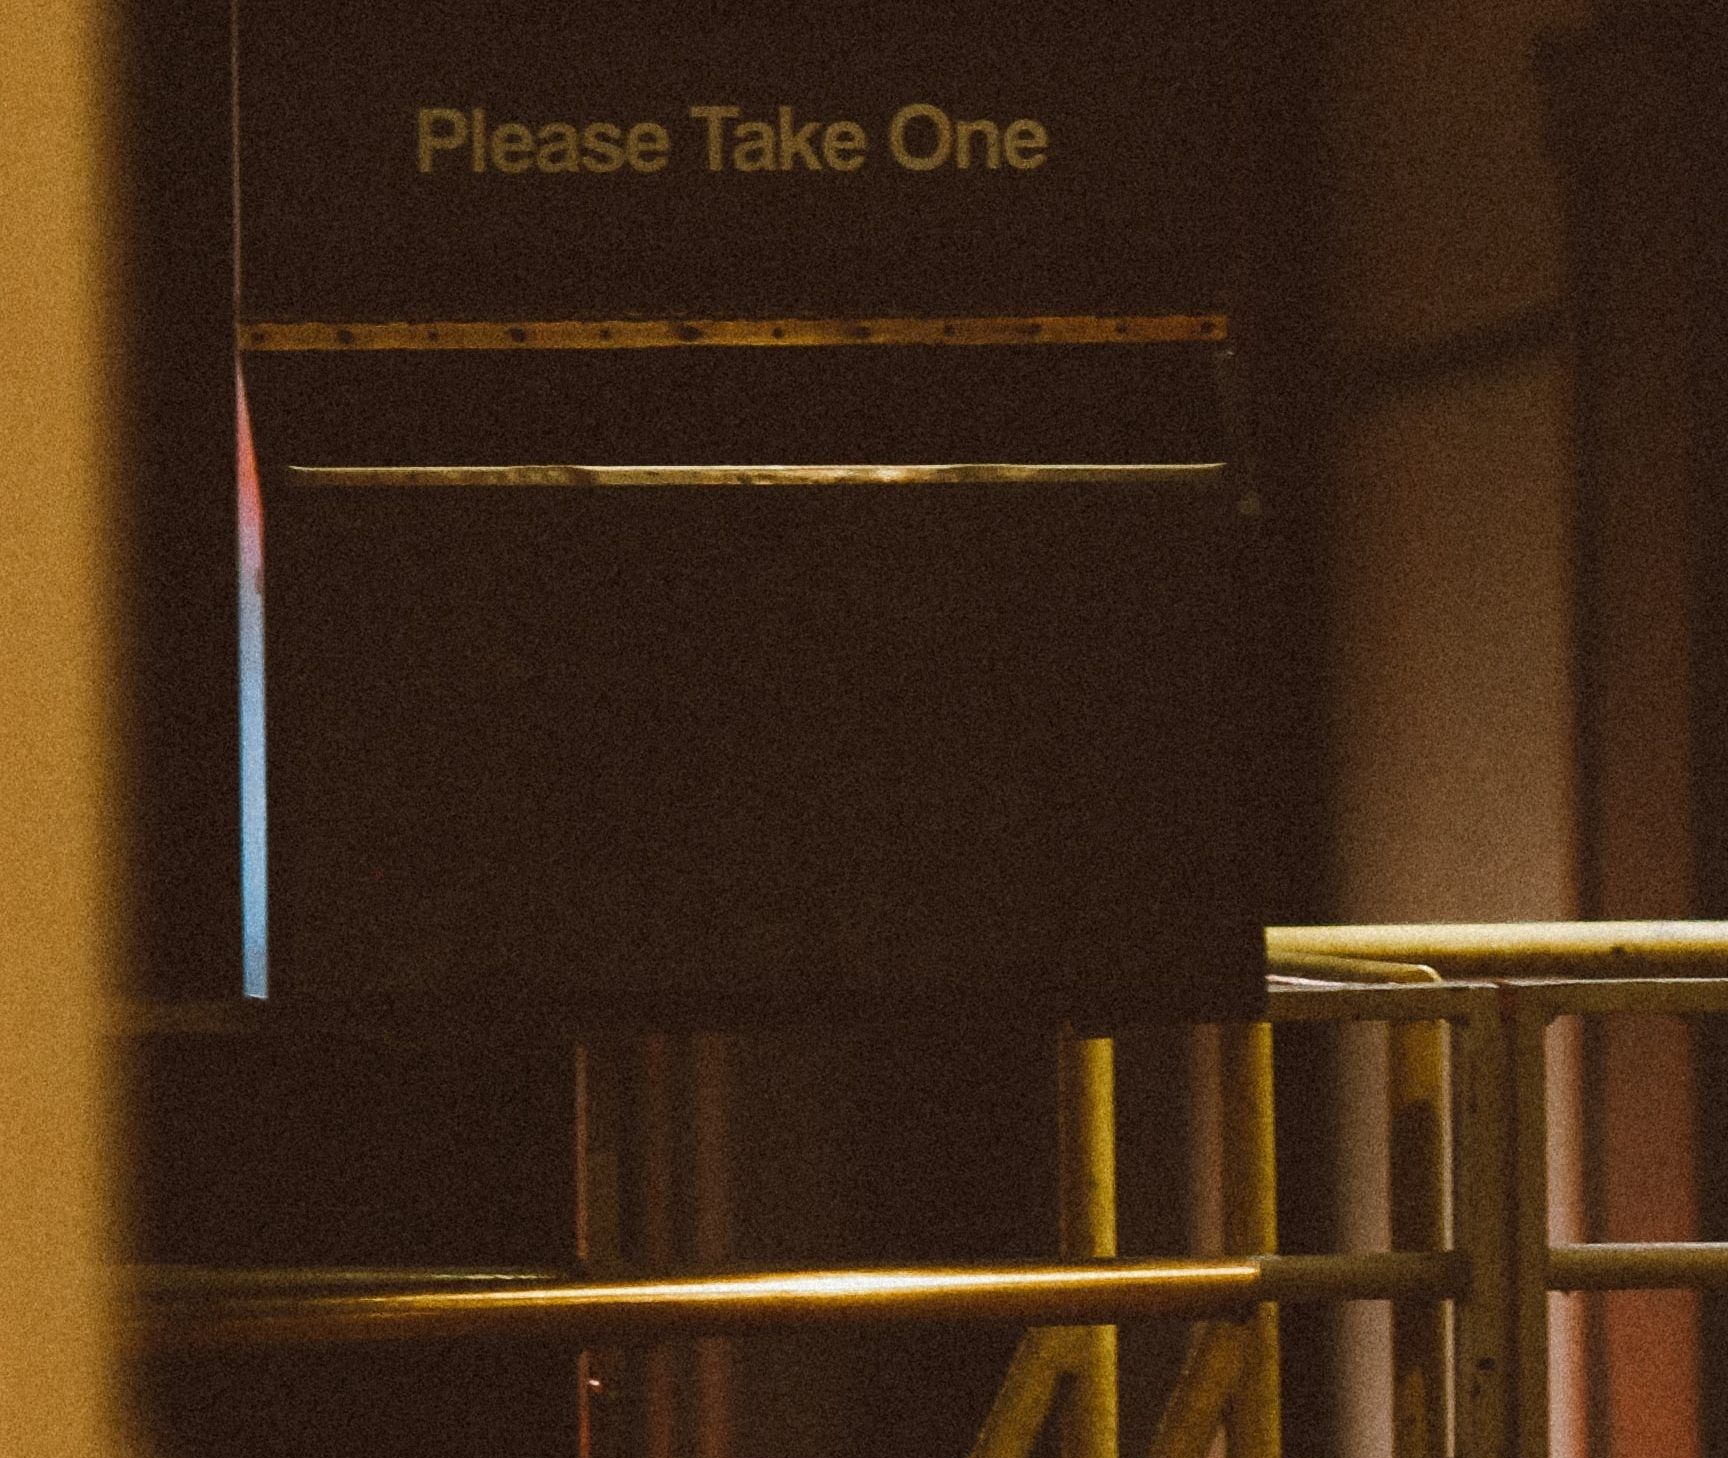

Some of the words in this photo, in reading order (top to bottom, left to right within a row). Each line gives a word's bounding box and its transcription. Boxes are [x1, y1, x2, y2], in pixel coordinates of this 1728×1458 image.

[416, 106, 671, 174] Please
[689, 104, 869, 173] Take
[887, 102, 1050, 171] One
